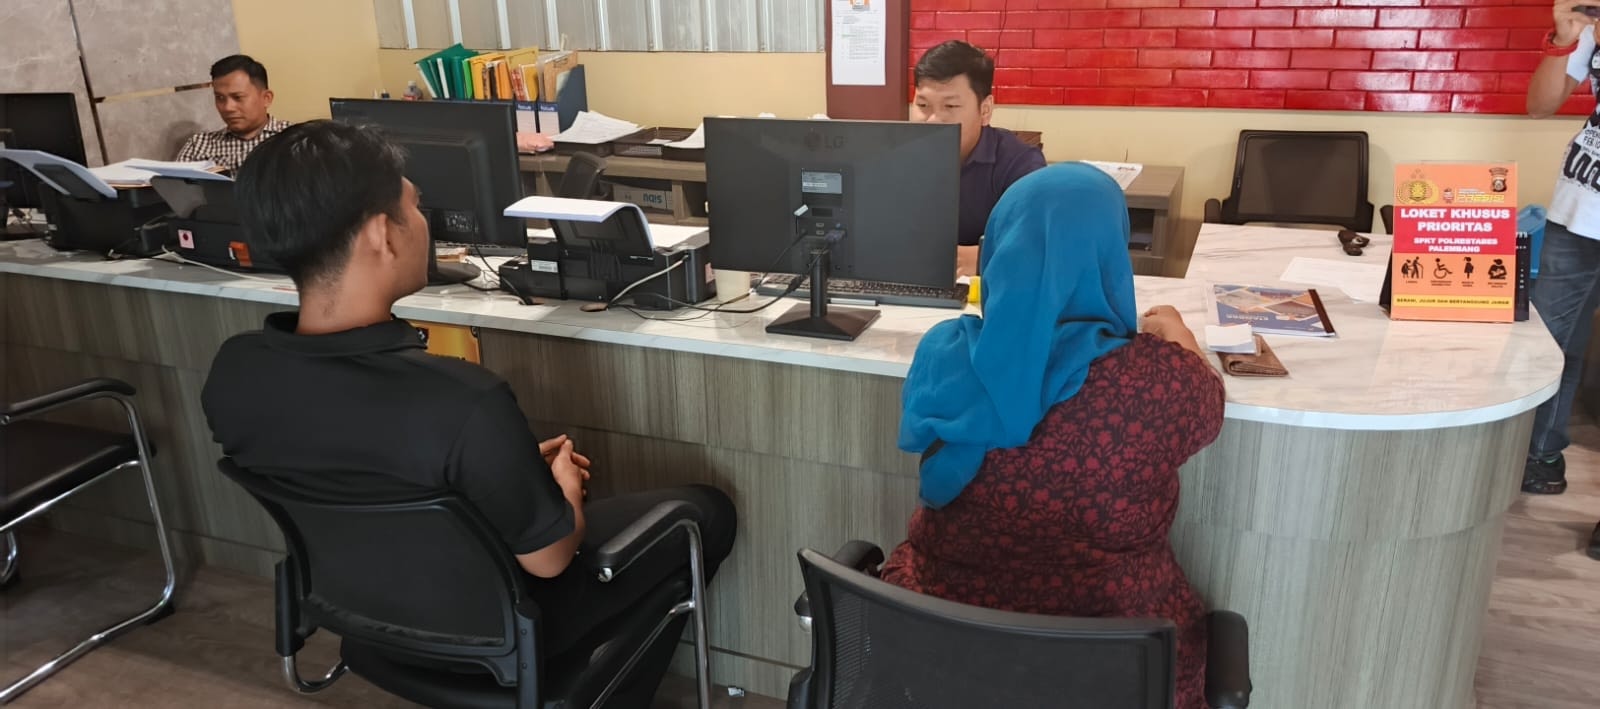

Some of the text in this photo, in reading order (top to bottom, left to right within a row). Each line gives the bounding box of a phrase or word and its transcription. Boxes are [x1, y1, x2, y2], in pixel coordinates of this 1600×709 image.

[824, 135, 846, 149] LG
[1400, 208, 1510, 219] LOKET KHUSUS
[1417, 221, 1493, 232] PRIORITAS
[1413, 237, 1498, 246] SPKT POLRESTABES
[1428, 245, 1481, 253] PALEMBANG
